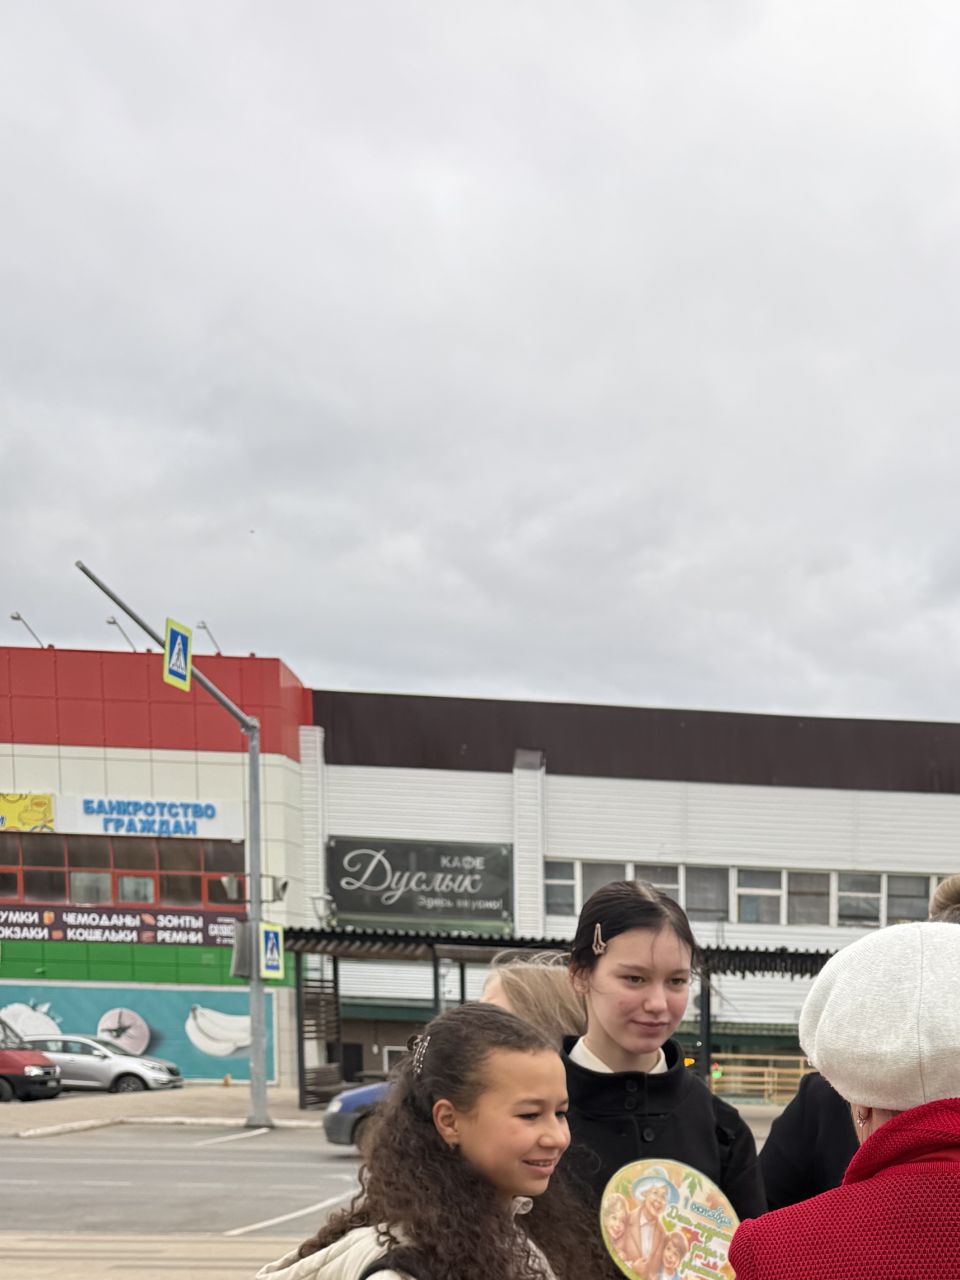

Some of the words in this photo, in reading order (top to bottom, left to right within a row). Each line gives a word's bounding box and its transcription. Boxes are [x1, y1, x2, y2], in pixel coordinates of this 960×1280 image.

[83, 799, 217, 819] БАНКРОТСТВО
[103, 817, 198, 836] ГРАЖДАН
[440, 855, 486, 870] КАФЕ
[62, 911, 140, 928] ЧЕМОДАНЫ
[157, 914, 203, 930] ЗОНТЫ
[66, 927, 138, 942] КОШЕЛЬКИ
[157, 929, 203, 944] РЕМНИ
